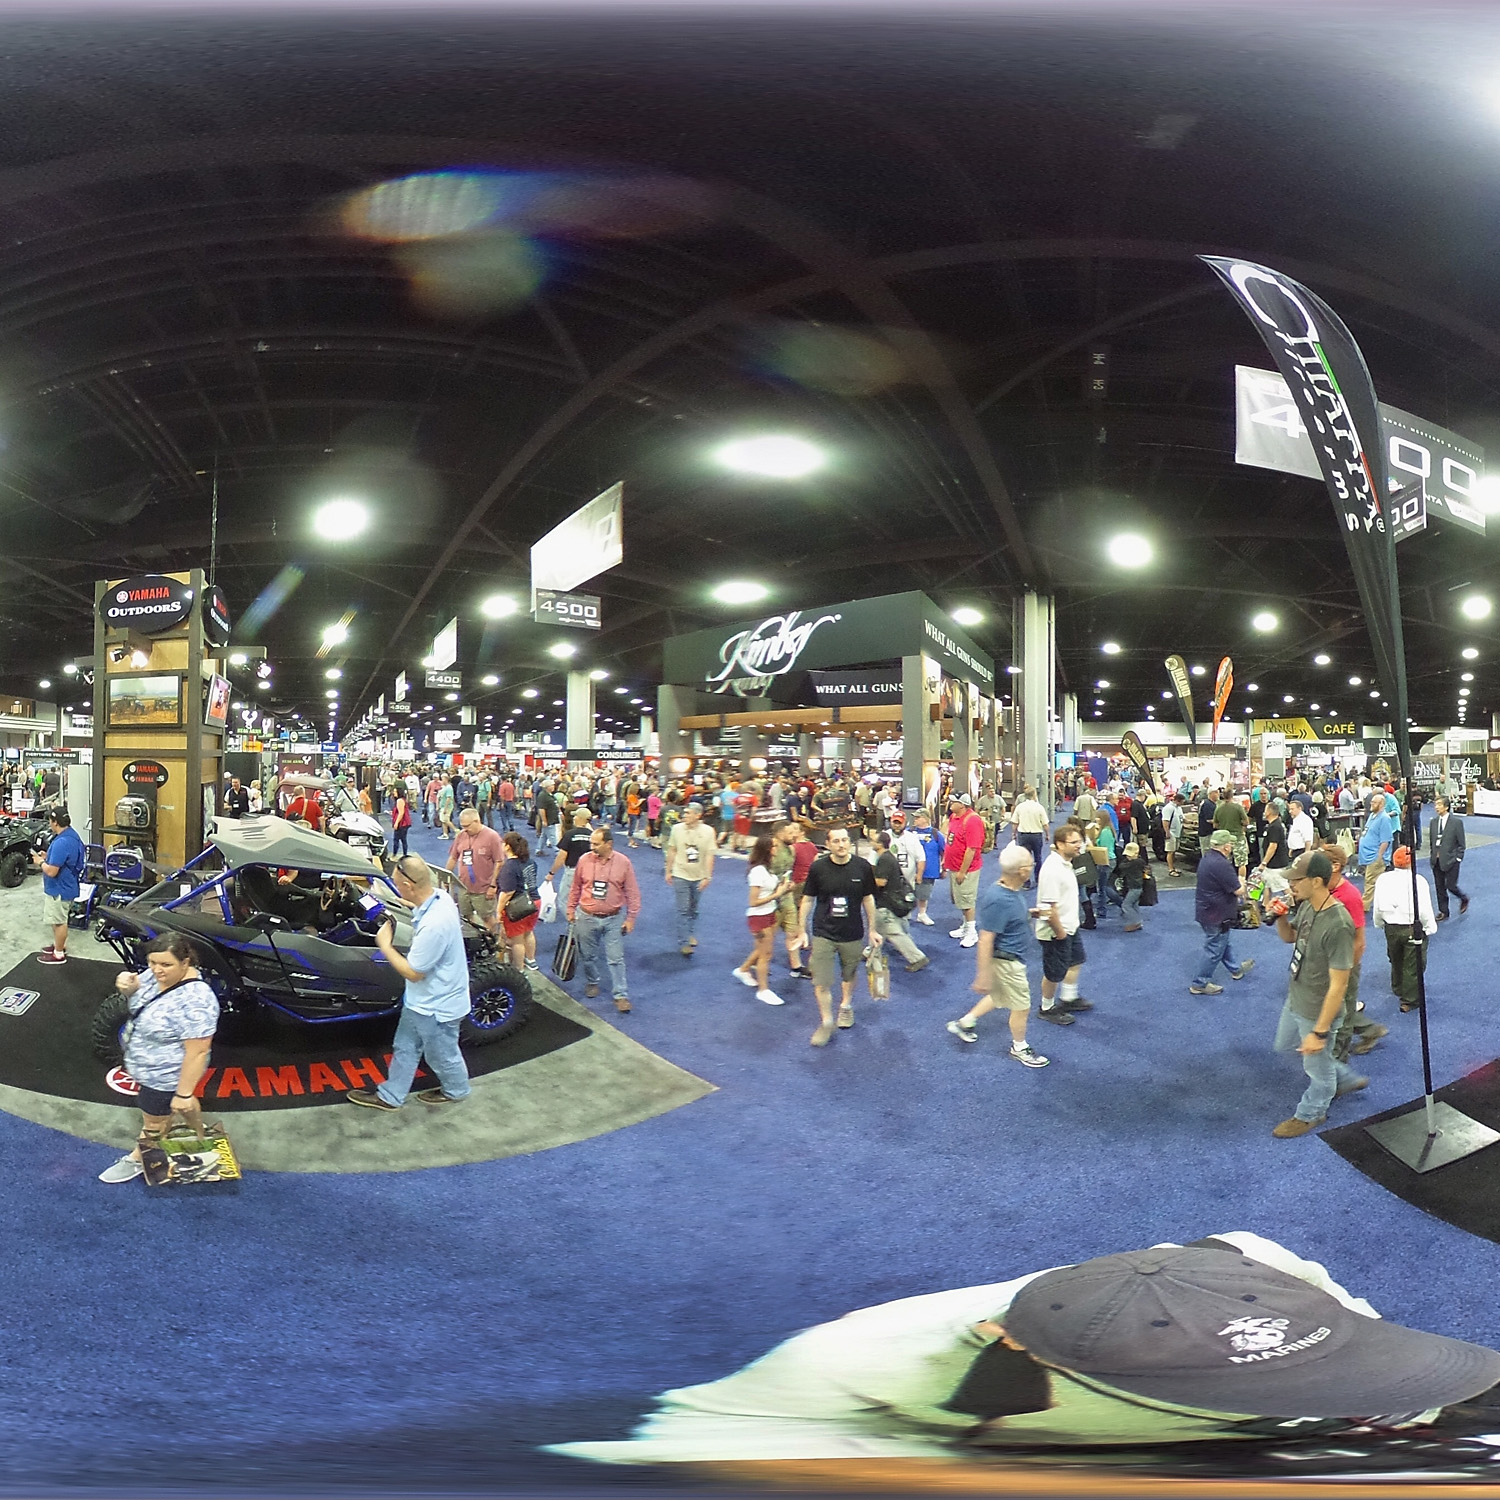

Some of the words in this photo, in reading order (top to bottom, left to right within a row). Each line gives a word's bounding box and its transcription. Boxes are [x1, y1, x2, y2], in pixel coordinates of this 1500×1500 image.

[128, 586, 170, 601] YAMAHA
[108, 601, 182, 618] OUTDOORS
[540, 600, 598, 618] 4500
[925, 619, 946, 647] WHAT
[945, 638, 957, 656] ALL
[427, 674, 460, 684] 4400
[815, 685, 847, 694] WHAT
[849, 684, 869, 693] ALL
[871, 683, 904, 693] GUNS
[1323, 721, 1356, 734] CAFÉ
[596, 751, 641, 759] CONSUMER
[136, 764, 159, 773] YAMAHA
[192, 1053, 428, 1098] YAMAH
[1228, 1326, 1332, 1364] MARINES
